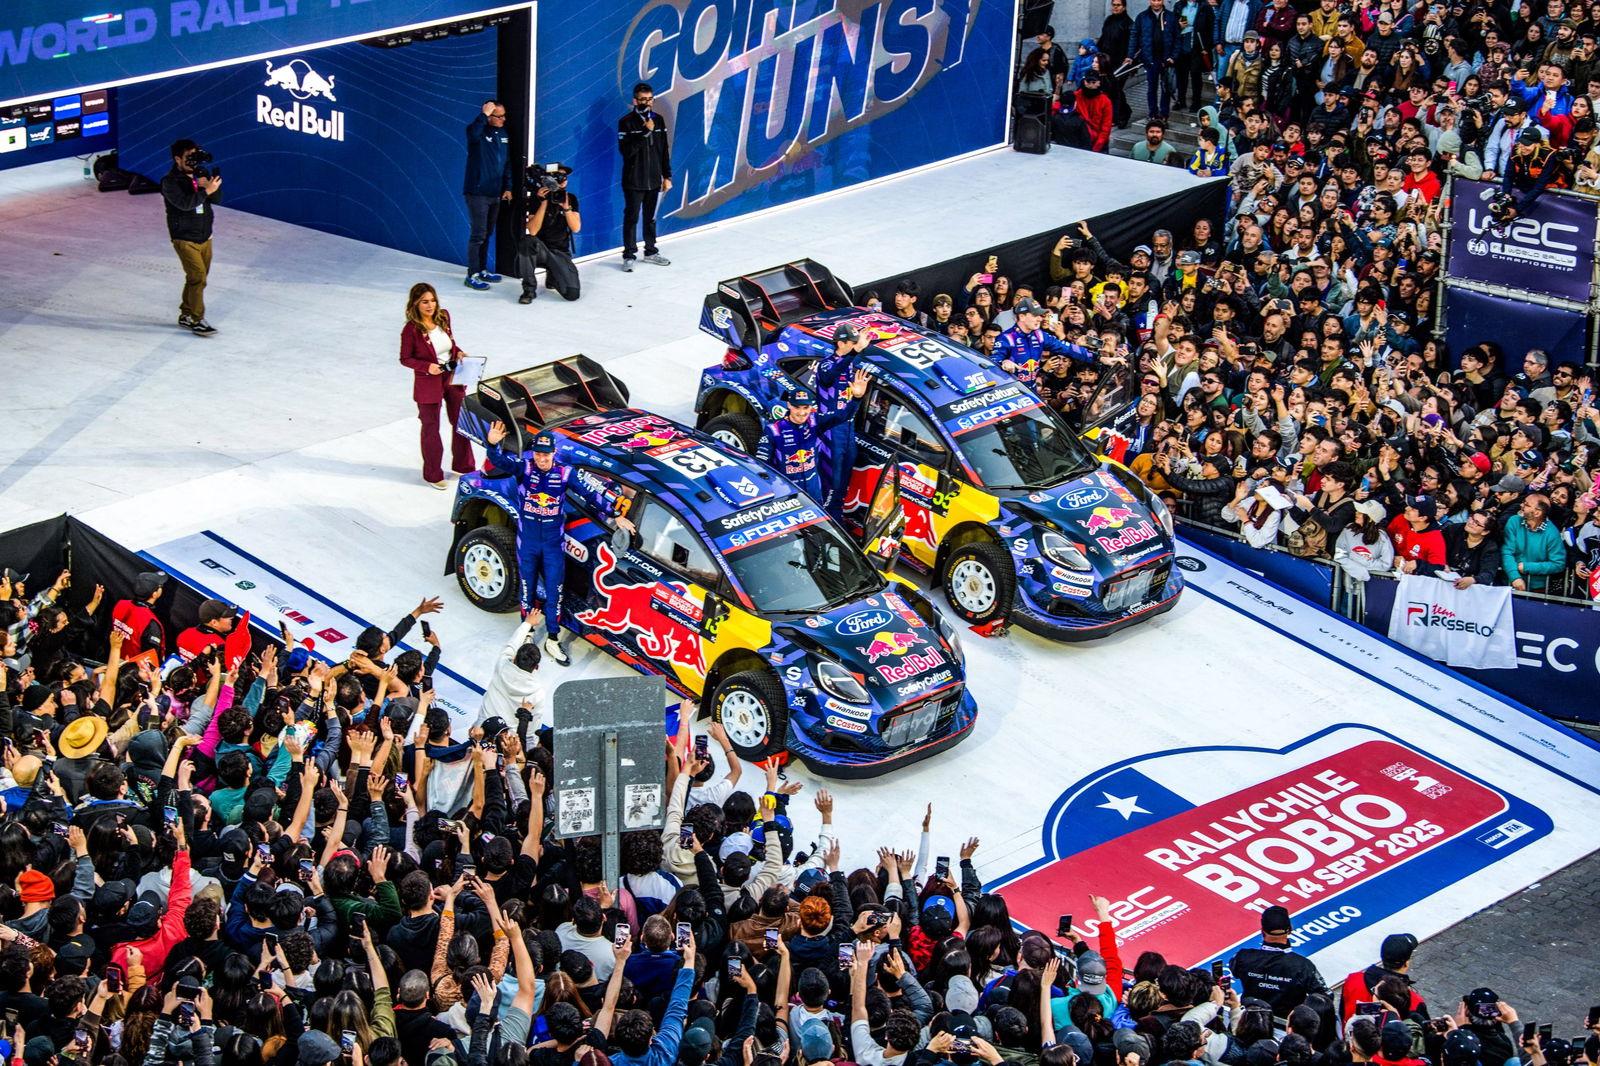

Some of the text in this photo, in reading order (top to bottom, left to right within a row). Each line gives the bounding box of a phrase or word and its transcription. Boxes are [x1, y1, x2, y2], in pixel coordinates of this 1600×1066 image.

[0, 7, 157, 67] WORLD
[256, 95, 345, 142] Red Bull
[1491, 254, 1575, 272] CHAMPIONSHIP
[901, 341, 950, 366] 55
[949, 386, 1020, 415] SafetyCulture
[969, 396, 1036, 424] FORUM8
[580, 422, 630, 447] Bull
[623, 415, 671, 435] Red
[671, 449, 725, 475] 13
[524, 501, 560, 517] Red Bull
[1066, 489, 1103, 508] Ford
[720, 497, 802, 531] SafetyCulture
[743, 508, 818, 542] FORUM8
[565, 539, 586, 561] trol
[1096, 519, 1159, 555] Red Bull
[1062, 584, 1091, 597] Castrol
[704, 614, 725, 635] 13
[847, 612, 887, 634] Ford
[876, 645, 946, 684] Red Bull
[898, 669, 952, 697] SafetyCulture
[1456, 697, 1505, 723] SafetyCulture
[835, 718, 865, 731] Castrol
[1182, 793, 1409, 904] BIOBÍO
[1282, 879, 1326, 900] 14
[1312, 846, 1386, 886] SEPT
[1375, 818, 1446, 857] 2025
[1128, 907, 1192, 942] CHAMPIONSHIP
